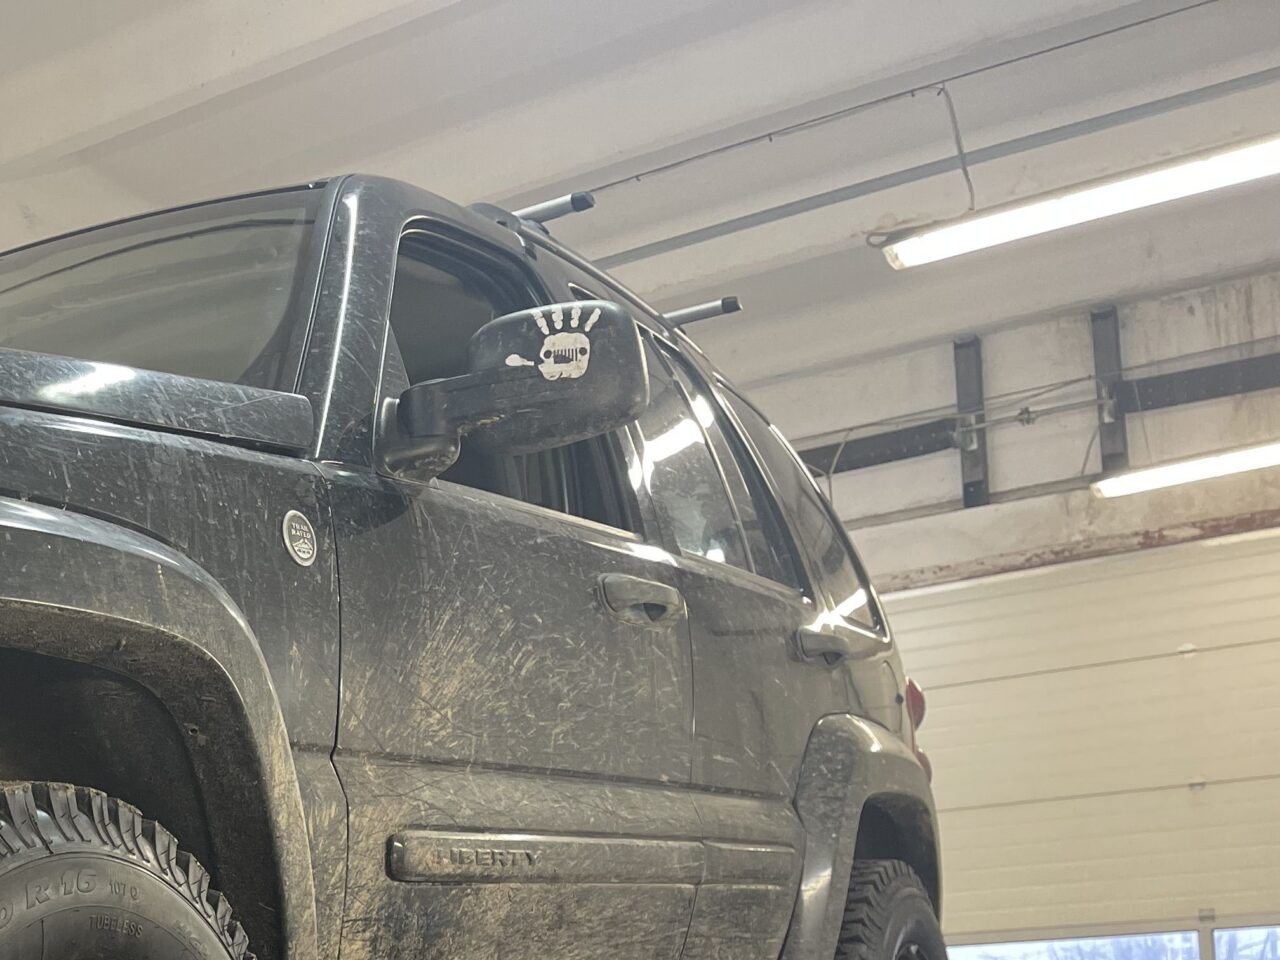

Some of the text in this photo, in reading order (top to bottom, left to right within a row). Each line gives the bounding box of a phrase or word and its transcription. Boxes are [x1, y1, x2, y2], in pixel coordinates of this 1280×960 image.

[291, 528, 311, 539] RATED
[435, 847, 542, 867] LIBERTY
[87, 913, 144, 939] TUBELESS
